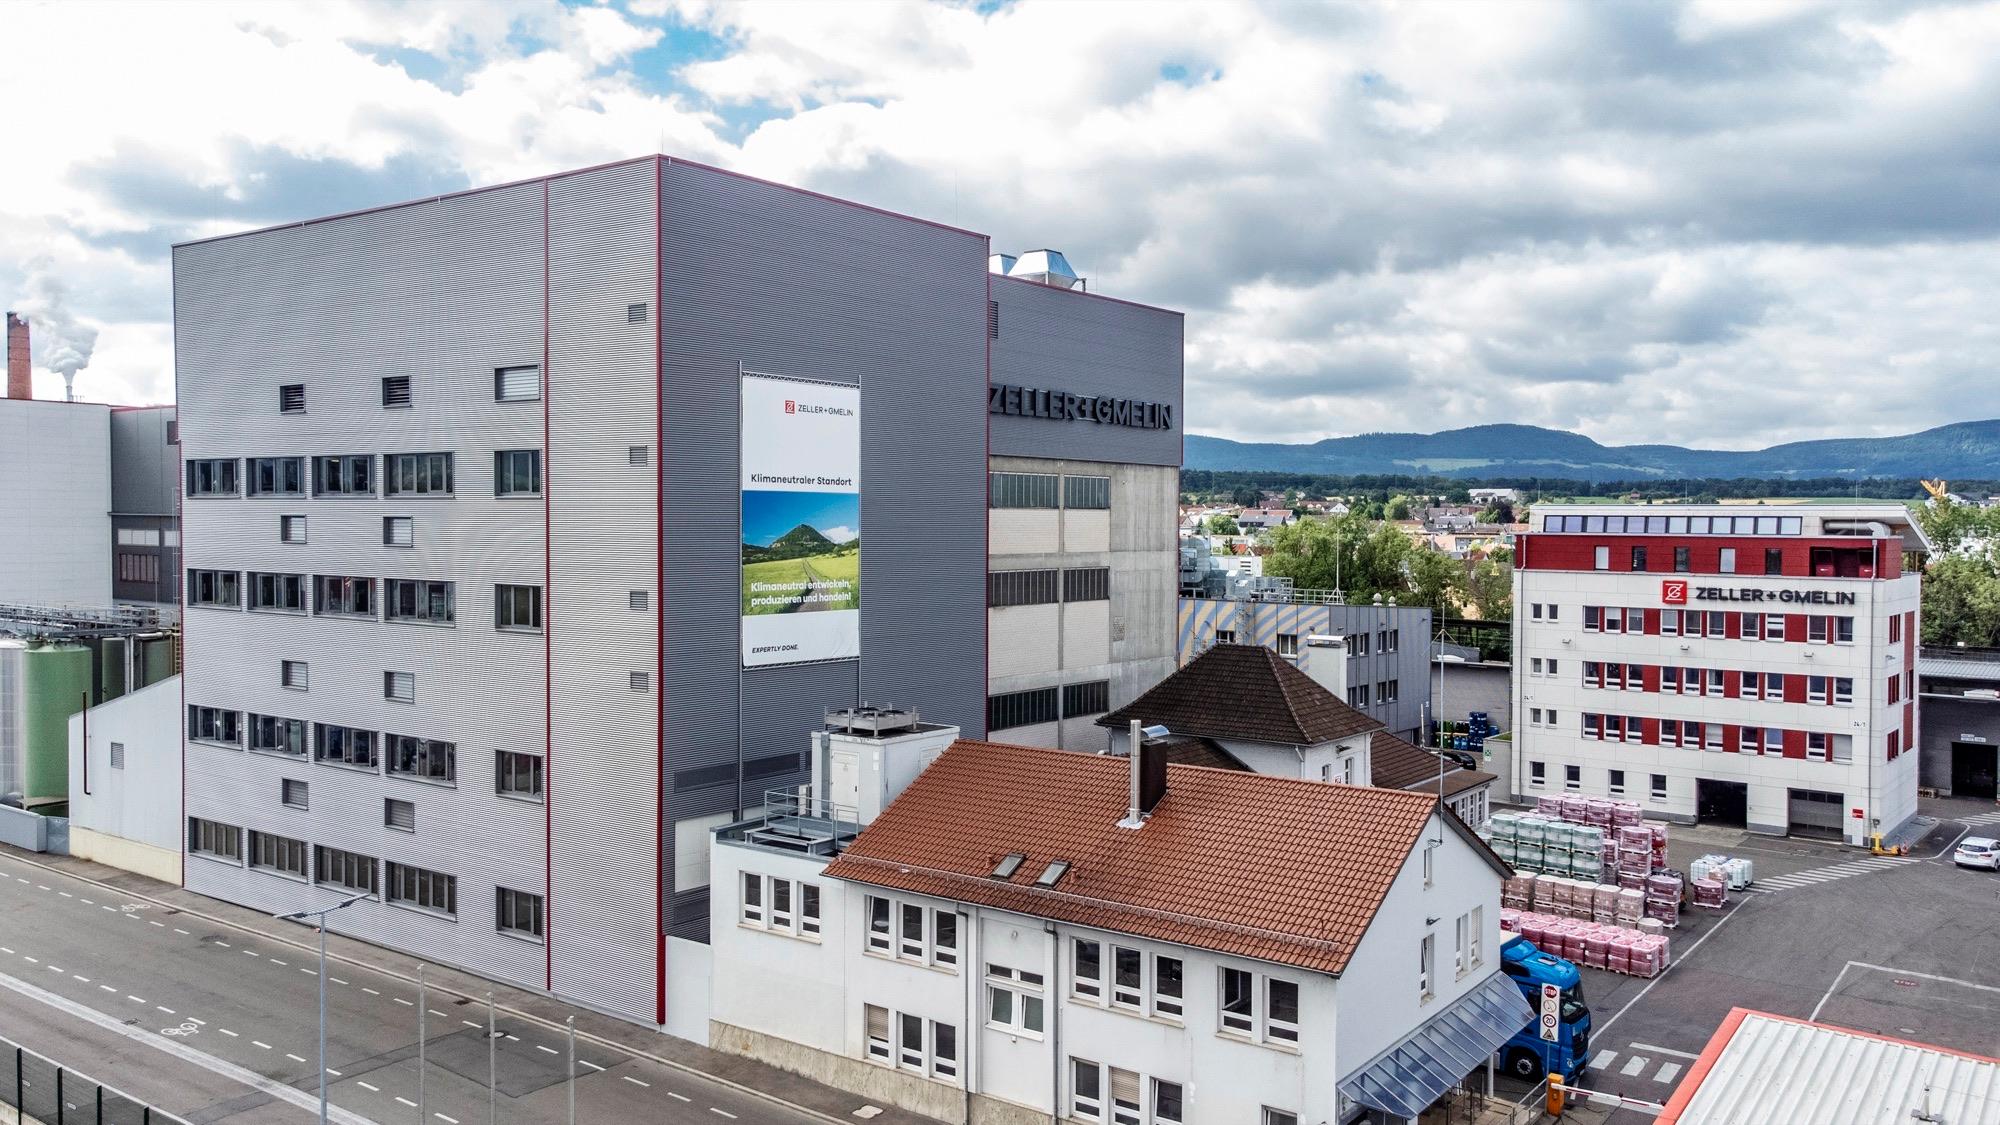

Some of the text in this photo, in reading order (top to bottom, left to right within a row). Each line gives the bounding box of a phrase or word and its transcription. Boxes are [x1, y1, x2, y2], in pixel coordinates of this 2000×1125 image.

[751, 473, 852, 487] Klimaneutraler Standort
[751, 579, 852, 592] Klimaneutral entwickeln,
[751, 592, 852, 608] produzieren und handeln!
[752, 645, 781, 654] EXPERTLY
